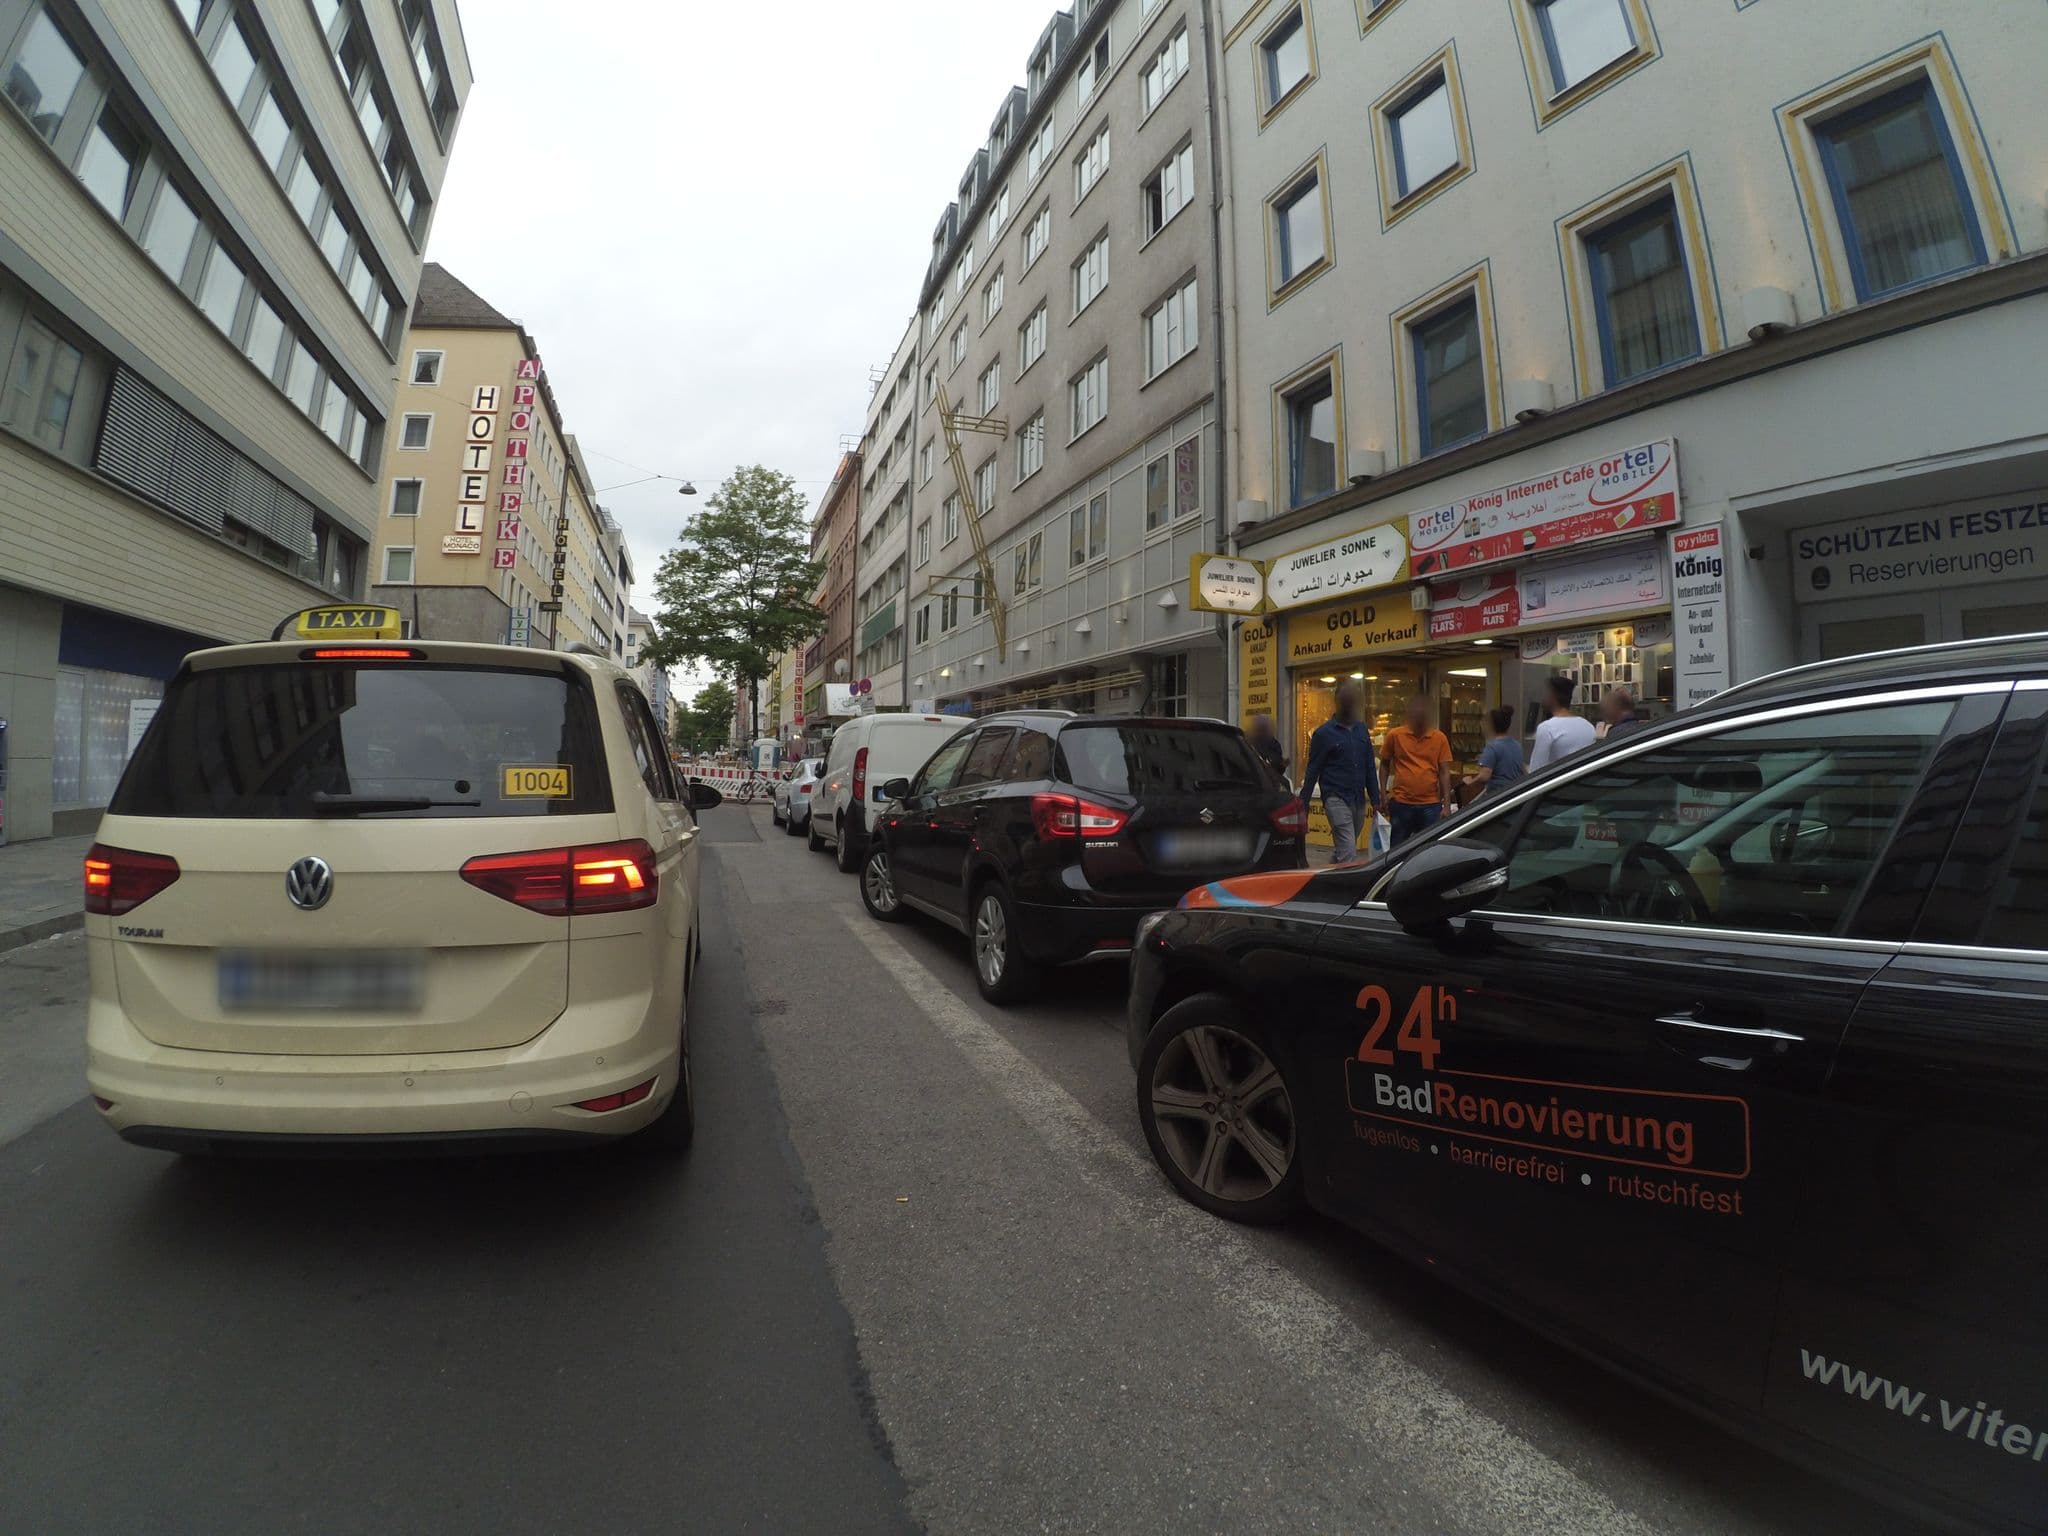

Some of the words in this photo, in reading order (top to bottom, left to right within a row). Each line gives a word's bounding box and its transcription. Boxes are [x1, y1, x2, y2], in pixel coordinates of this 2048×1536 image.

[461, 387, 496, 531] HOTEL
[495, 360, 536, 567] APOTHEKE
[1600, 445, 1654, 477] ortel
[1601, 466, 1656, 487] MOBILE
[1468, 493, 1503, 512] König
[1506, 475, 1558, 501] Internet
[1563, 464, 1595, 486] Café
[1418, 506, 1456, 529] ortel
[449, 535, 474, 544] HOTEL
[1419, 522, 1456, 537] MOBILE
[1799, 519, 1941, 560] SCHÜTZEN
[1950, 502, 2048, 539] FESTZE
[443, 542, 480, 550] MONACO
[1290, 548, 1336, 571] JUWELIER
[1341, 536, 1376, 557] SONNE
[553, 520, 567, 595] HOTEL
[1675, 554, 1723, 578] König
[1849, 546, 2034, 585] Reservierungen
[1207, 572, 1234, 582] JUWELIER
[1237, 576, 1255, 585] SONNE
[1291, 575, 1323, 599] الشمس
[1327, 567, 1373, 587] مجوهرات
[1677, 582, 1722, 600] Internetcafé
[318, 611, 375, 628] TAXI
[1327, 606, 1376, 631] GOLD
[1483, 603, 1510, 615] ALLNET
[1700, 607, 1713, 618] und
[1431, 621, 1455, 632] FLATS
[1483, 615, 1505, 626] FLATS
[1689, 621, 1714, 635] Verkauf
[1244, 626, 1274, 642] GOLD
[1293, 639, 1332, 657] Ankauf
[1343, 634, 1353, 650] &
[1365, 624, 1418, 645] Verkauf
[513, 771, 564, 792] 1004
[118, 926, 164, 938] TOURAN
[1374, 1072, 1694, 1165] BadRenovierung
[1353, 1119, 1421, 1153] fugenlos
[1450, 1141, 1565, 1184] barrierefrei
[1608, 1172, 1743, 1216] rutschfest
[1801, 1348, 2048, 1462] www.viter
